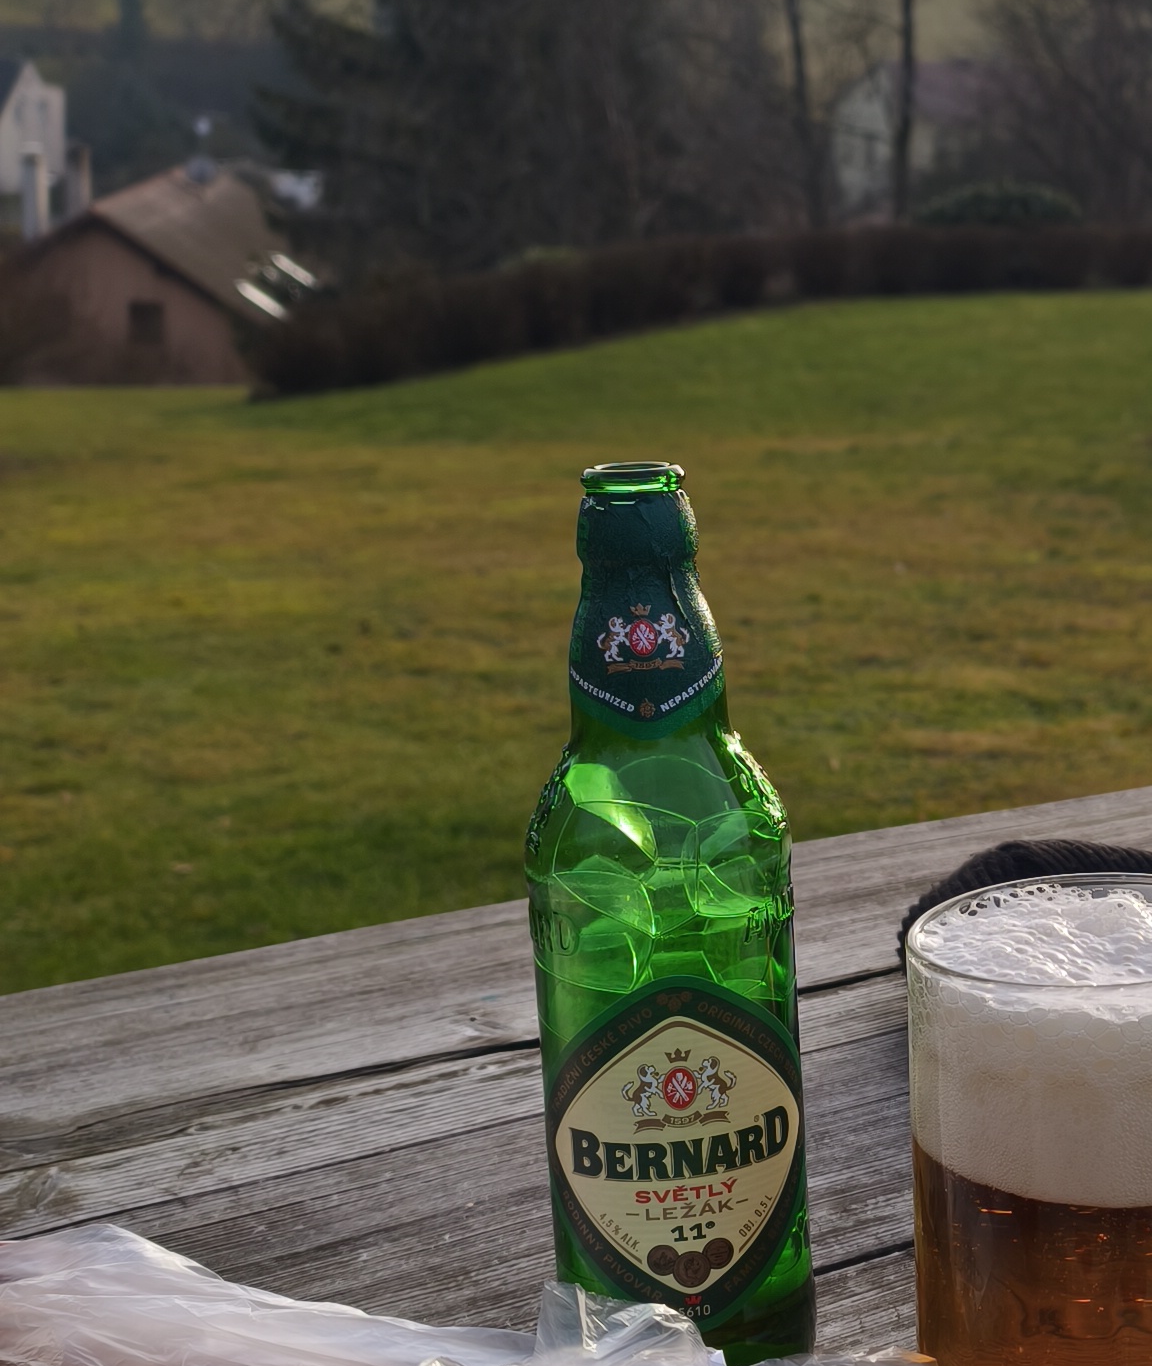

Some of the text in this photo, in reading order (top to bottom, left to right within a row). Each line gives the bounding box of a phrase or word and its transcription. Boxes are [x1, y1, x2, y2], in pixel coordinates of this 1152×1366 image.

[580, 1030, 618, 1068] ČESKÉ
[617, 1007, 653, 1035] PIVO
[697, 1001, 756, 1039] ORIGINAL
[757, 1032, 785, 1062] CZECH
[568, 1105, 790, 1182] BERNARD
[669, 1114, 696, 1125] 1597
[635, 1176, 738, 1204] SVĚTLÝ
[602, 1253, 664, 1302] PIVOVAR
